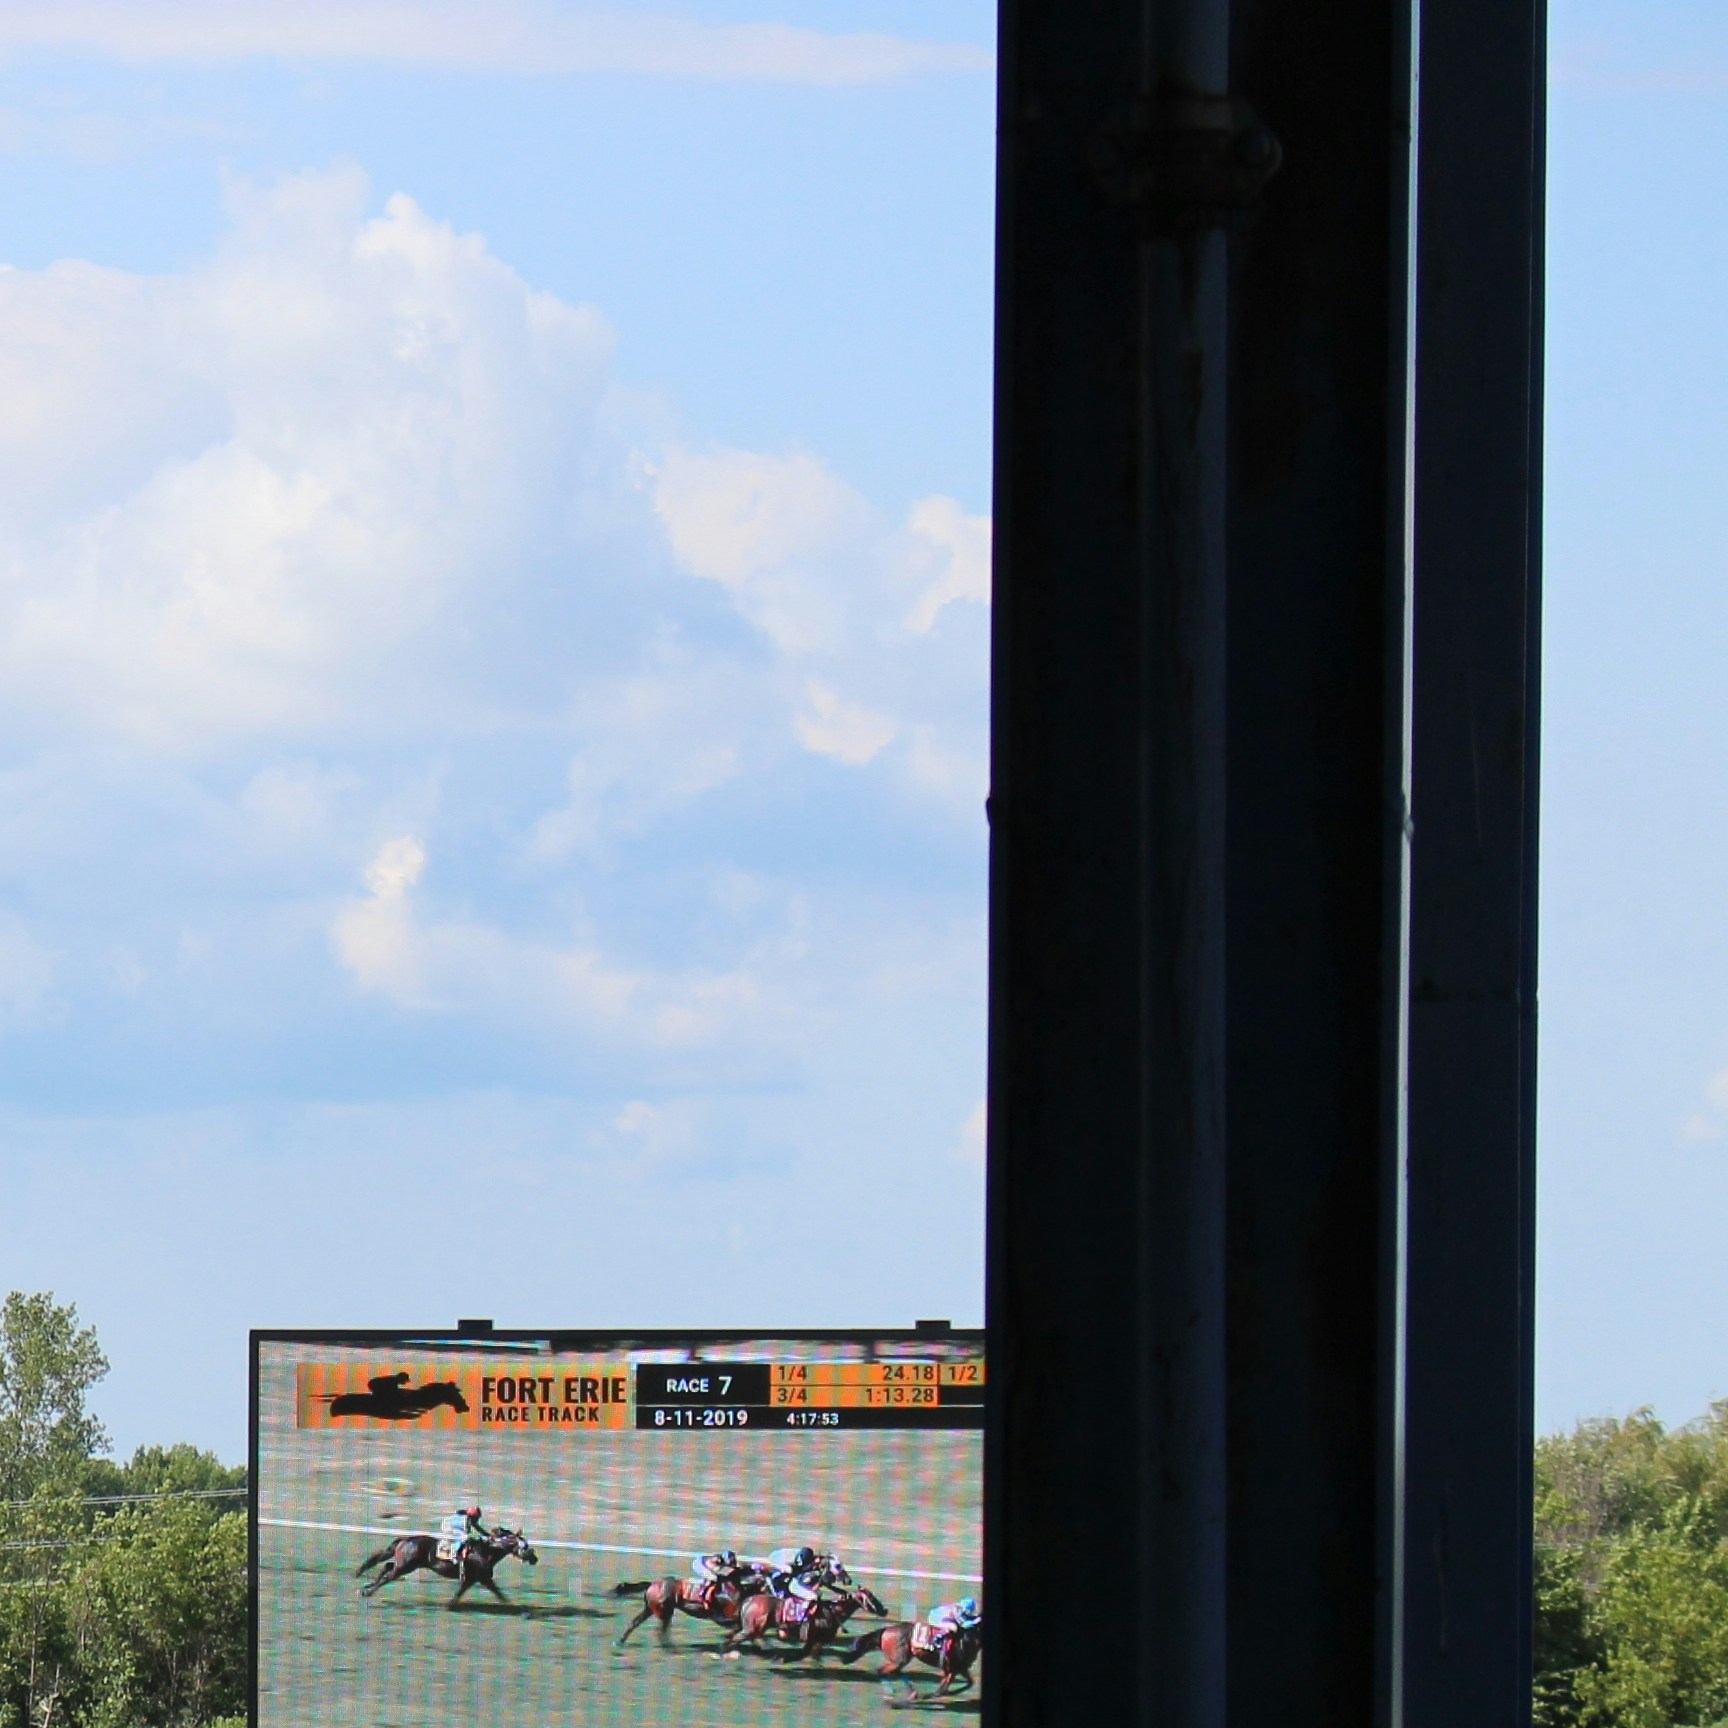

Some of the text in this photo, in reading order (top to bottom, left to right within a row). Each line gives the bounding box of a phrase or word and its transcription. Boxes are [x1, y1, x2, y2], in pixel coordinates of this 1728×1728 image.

[777, 1365, 935, 1382] 1/4 24.18
[948, 1365, 978, 1382] 1/2
[481, 1376, 627, 1404] FORT ERIE
[666, 1376, 733, 1396] RACE 7
[777, 1386, 935, 1404] 3/4 1:13.28
[481, 1406, 600, 1422] RACE TRACK
[654, 1409, 749, 1427] 8-11-2019
[786, 1411, 840, 1427] 4:17:53
